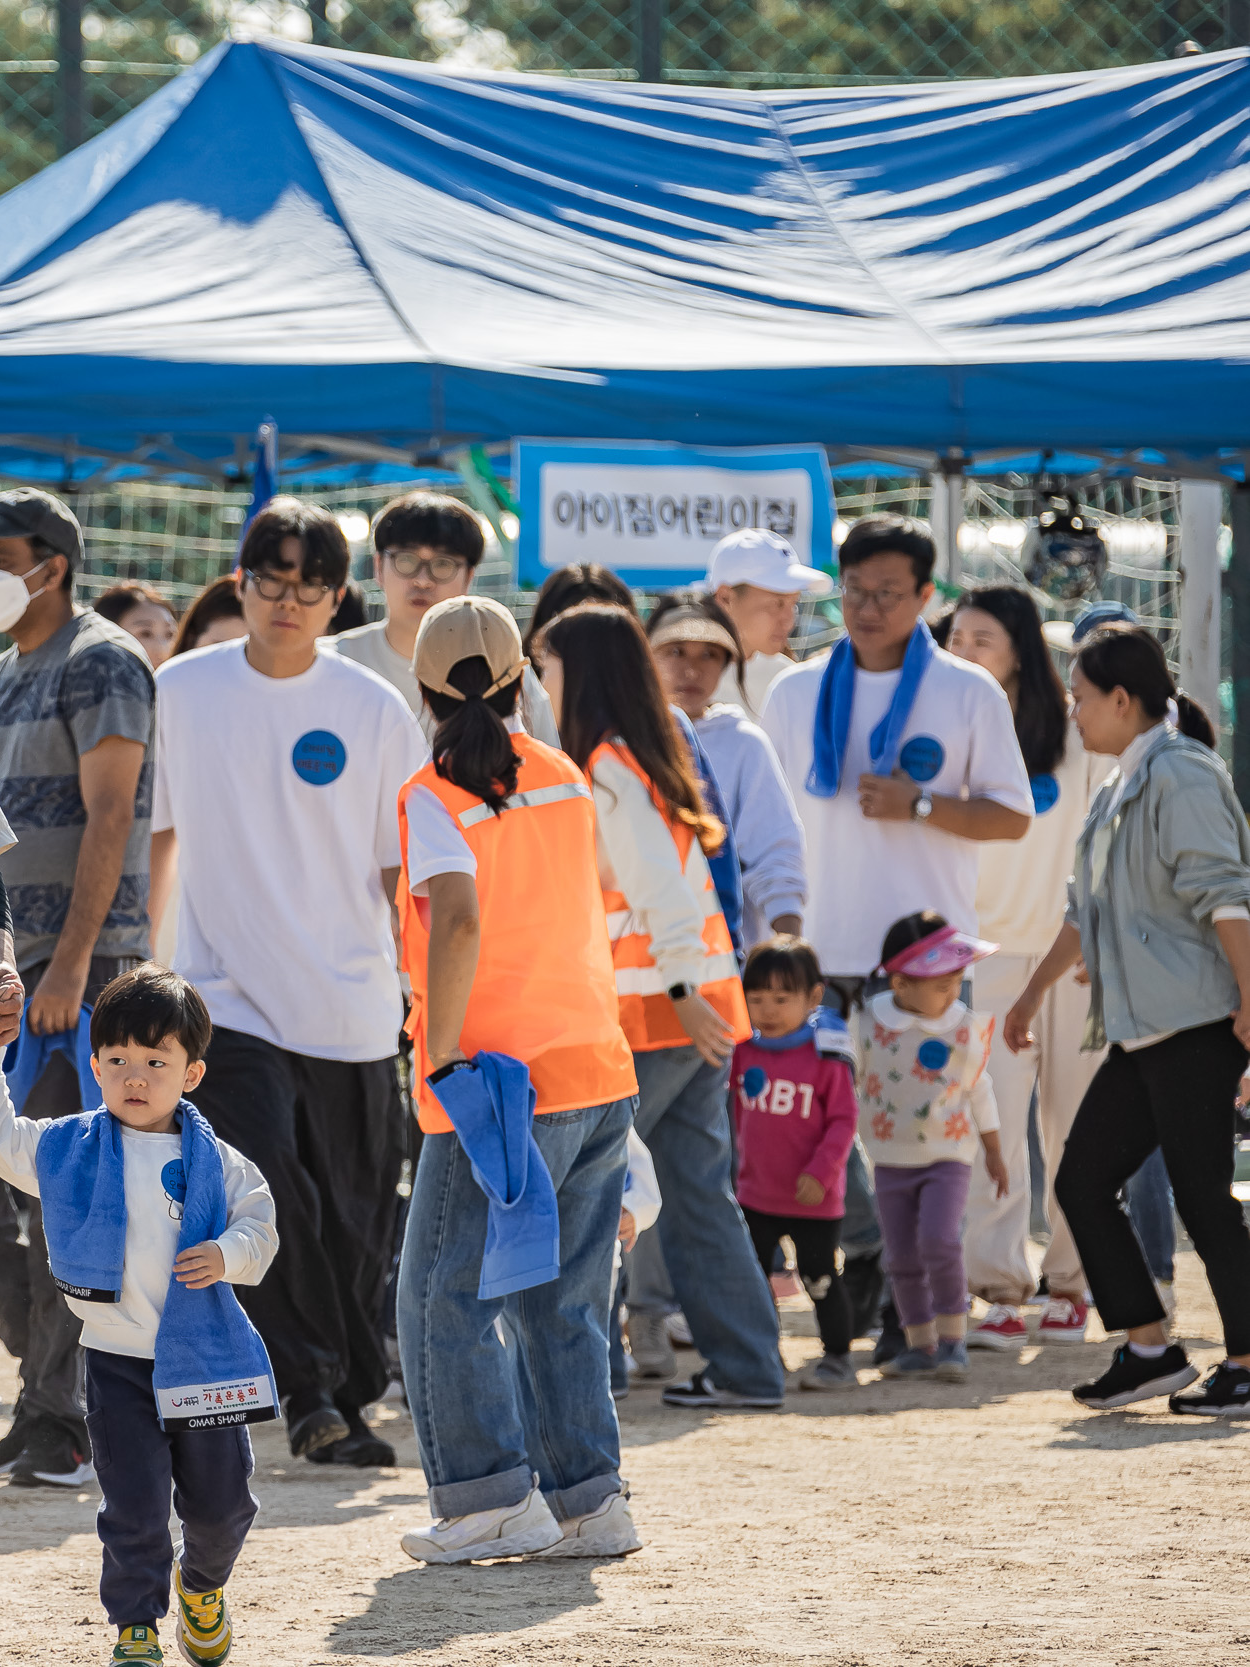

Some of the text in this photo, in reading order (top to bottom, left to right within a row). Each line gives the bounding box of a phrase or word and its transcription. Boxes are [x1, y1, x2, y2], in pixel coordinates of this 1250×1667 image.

[69, 1285, 92, 1297] SHARIF
[188, 1413, 247, 1428] OMAR SHARIF
